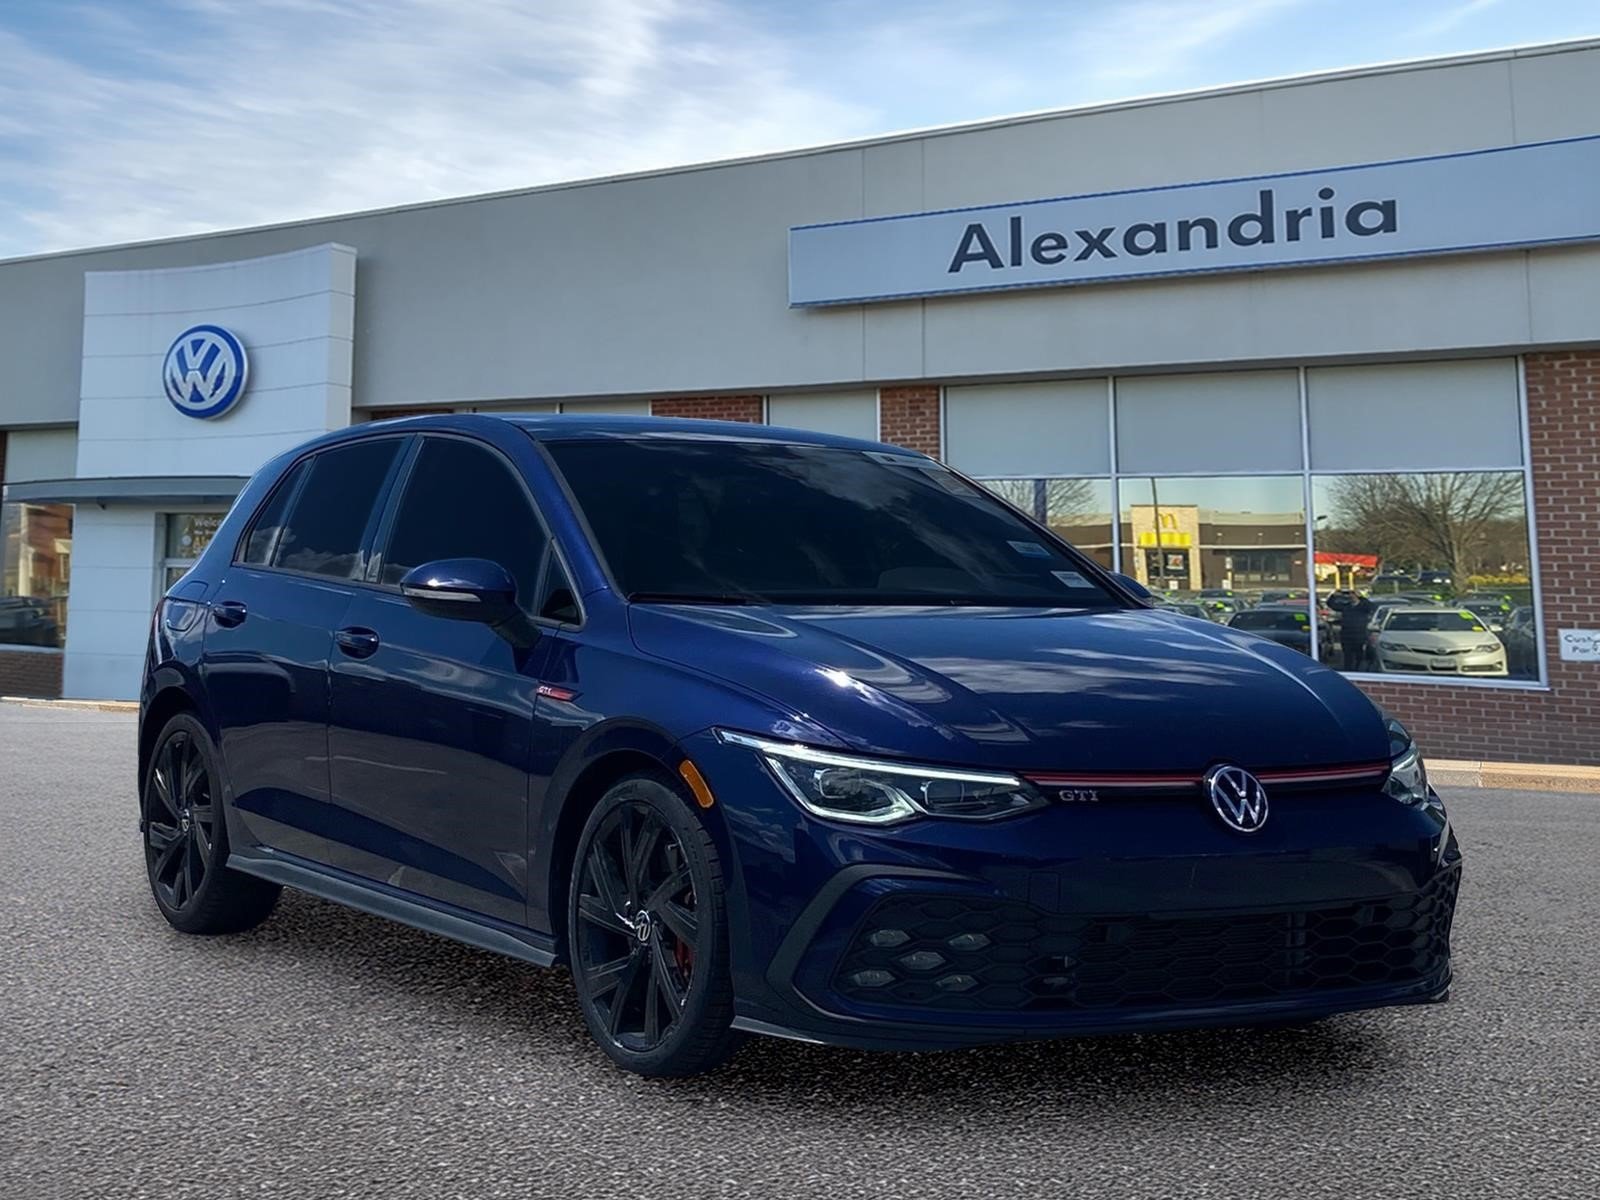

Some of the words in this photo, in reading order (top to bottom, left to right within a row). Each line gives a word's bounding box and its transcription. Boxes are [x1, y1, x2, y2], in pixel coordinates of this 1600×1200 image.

[948, 187, 1397, 273] Alexandria
[167, 331, 237, 409] VW
[1058, 789, 1099, 801] GTI
[1213, 768, 1265, 829] VW
